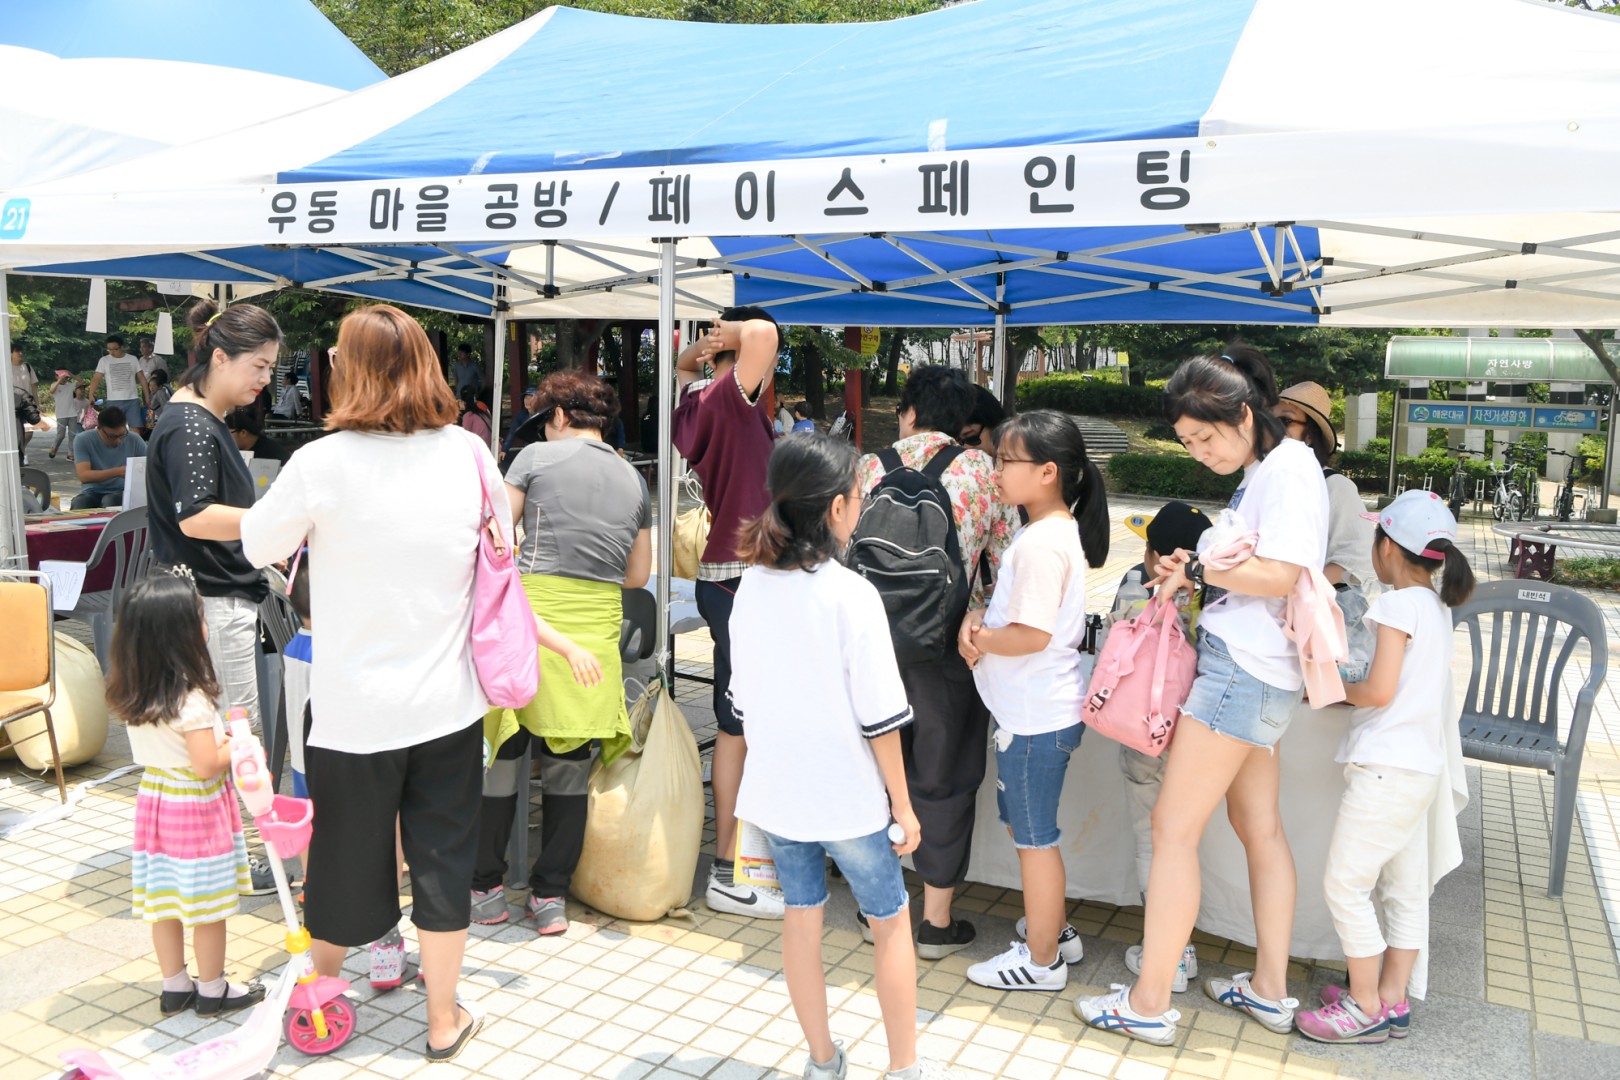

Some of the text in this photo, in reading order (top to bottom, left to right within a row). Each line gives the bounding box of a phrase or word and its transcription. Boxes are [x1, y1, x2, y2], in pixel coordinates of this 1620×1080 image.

[3, 206, 27, 231] 21
[267, 189, 338, 234] 우동
[369, 183, 450, 233] 마을
[1432, 408, 1527, 423] 해운대구 자전거생활화
[1522, 591, 1546, 600] 내빈석
